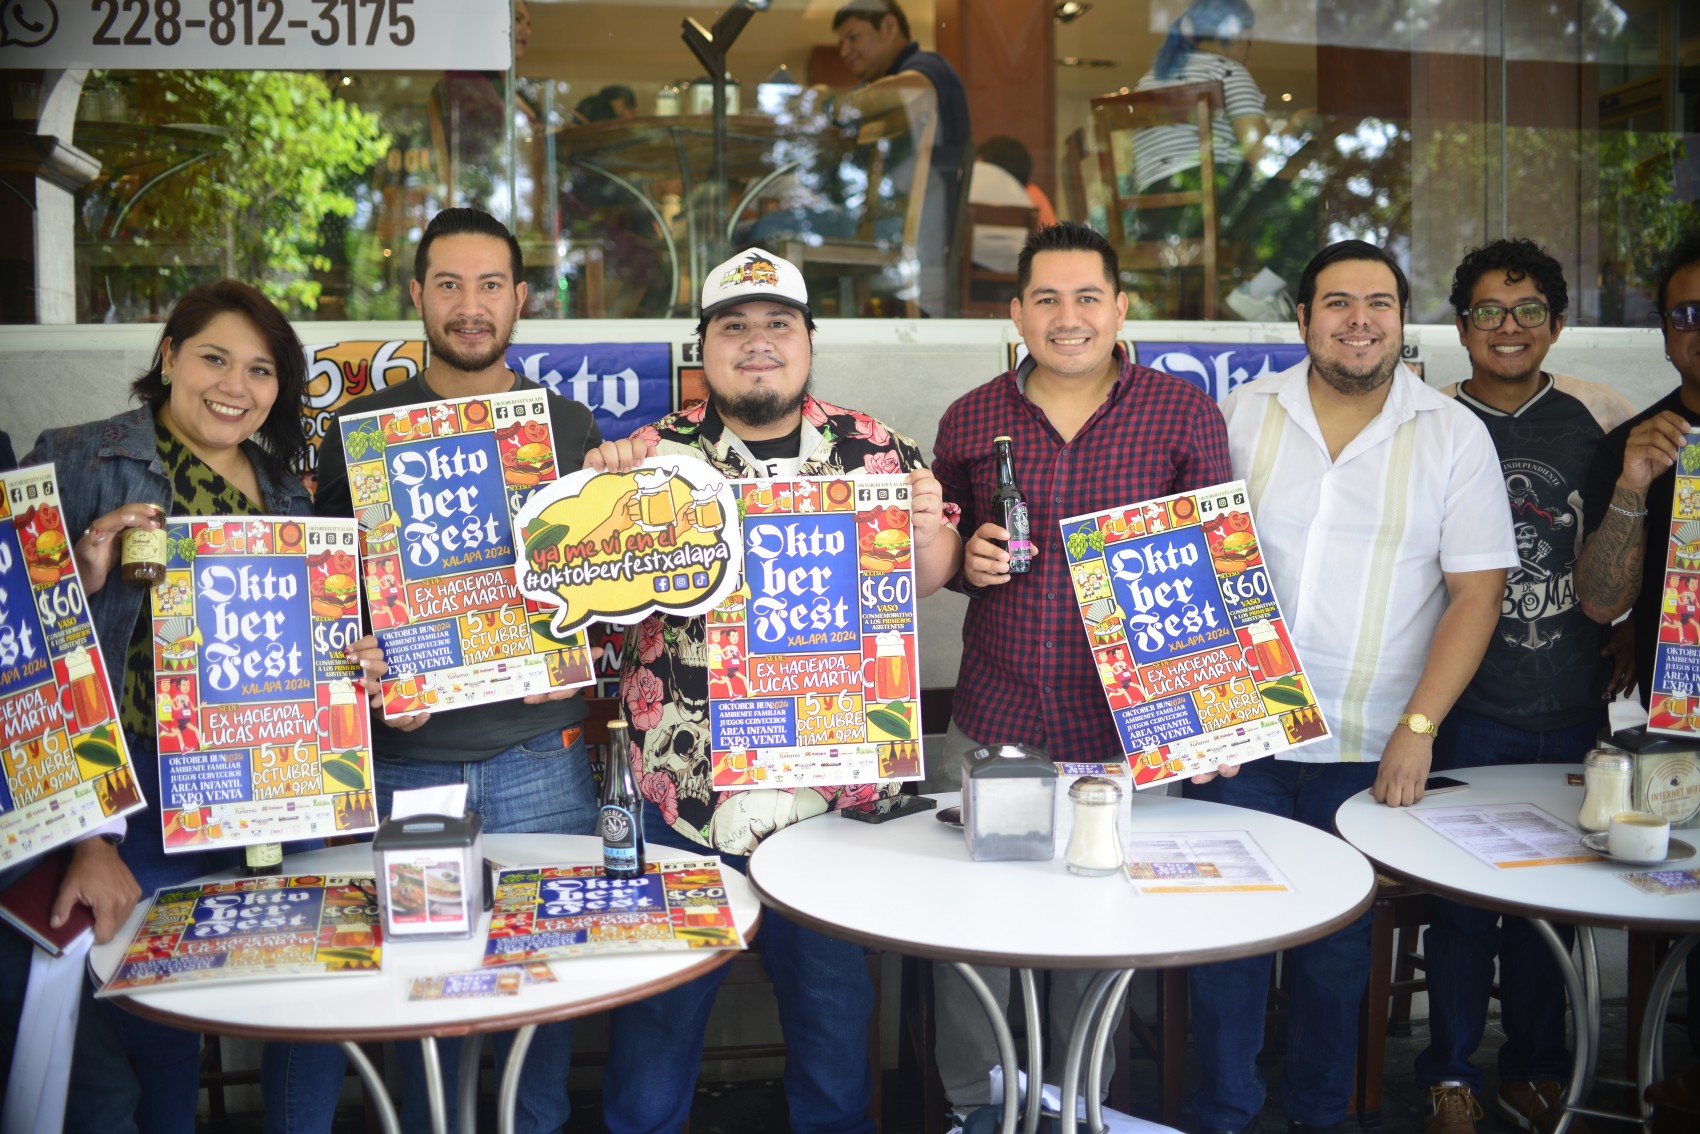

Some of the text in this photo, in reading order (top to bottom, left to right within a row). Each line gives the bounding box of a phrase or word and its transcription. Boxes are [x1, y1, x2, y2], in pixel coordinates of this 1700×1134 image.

[92, 0, 416, 46] 228-812-3175
[301, 343, 343, 409] 5
[343, 359, 368, 395] y
[518, 352, 640, 418] kto
[390, 446, 488, 484] Okto
[406, 484, 479, 522] ber
[404, 512, 501, 566] Fest
[533, 524, 676, 569] ya me vi en el
[747, 523, 844, 558] Okto
[442, 546, 510, 569] XALAPA 2024
[526, 543, 729, 590] #oktoberfestxalapa
[1110, 541, 1199, 580] Okto
[198, 565, 297, 602] Okto
[760, 558, 832, 597] ber
[1223, 571, 1267, 605] $60
[1521, 582, 1534, 592] DE
[414, 587, 435, 603] EX
[862, 576, 910, 609] $60
[1126, 576, 1194, 613] ber
[1240, 598, 1260, 607] VASO
[410, 595, 459, 618] LUCAS
[466, 603, 515, 633] 5 y 6
[212, 602, 286, 643] ber
[753, 596, 849, 642] Fest
[1130, 600, 1220, 651] Fest
[315, 622, 358, 655] $60
[383, 628, 418, 640] OKTOBER
[462, 623, 530, 650] OCTUBRE
[788, 631, 856, 647] XALAPA 2024
[1168, 627, 1230, 652] XALAPA 2024
[501, 637, 531, 657] 9PM
[205, 642, 303, 691] Fest
[418, 655, 454, 669] VENTA
[757, 664, 776, 677] EX
[242, 678, 310, 695] XALAPA 2024
[750, 675, 799, 693] LUCAS
[1144, 673, 1191, 697] LUCAS
[1147, 669, 1166, 683] EX
[806, 689, 853, 715] 5 y 6
[1198, 676, 1244, 704] 5 y 6
[719, 702, 755, 710] OKTOBER
[1122, 705, 1156, 718] OKTOBER
[1156, 705, 1186, 716] FAMILIAR
[1198, 691, 1261, 720] OCTUBRE
[1237, 702, 1265, 722] 9PM
[209, 714, 230, 729] EX
[747, 726, 787, 734] INFANTIL
[797, 711, 865, 731] OCTUBRE
[1153, 718, 1191, 733] INFANTIL
[202, 725, 254, 745] LUCAS
[720, 734, 787, 746] EXPO VENTA
[836, 725, 864, 743] 9PM
[1131, 725, 1194, 749] EXPO VENTA
[261, 743, 276, 767] 5
[294, 738, 308, 763] 6
[253, 761, 321, 785] OCTUBRE
[206, 789, 243, 801] VENTA
[292, 776, 320, 795] 9PM
[1652, 788, 1684, 801] INTERNET
[667, 887, 724, 900] $60
